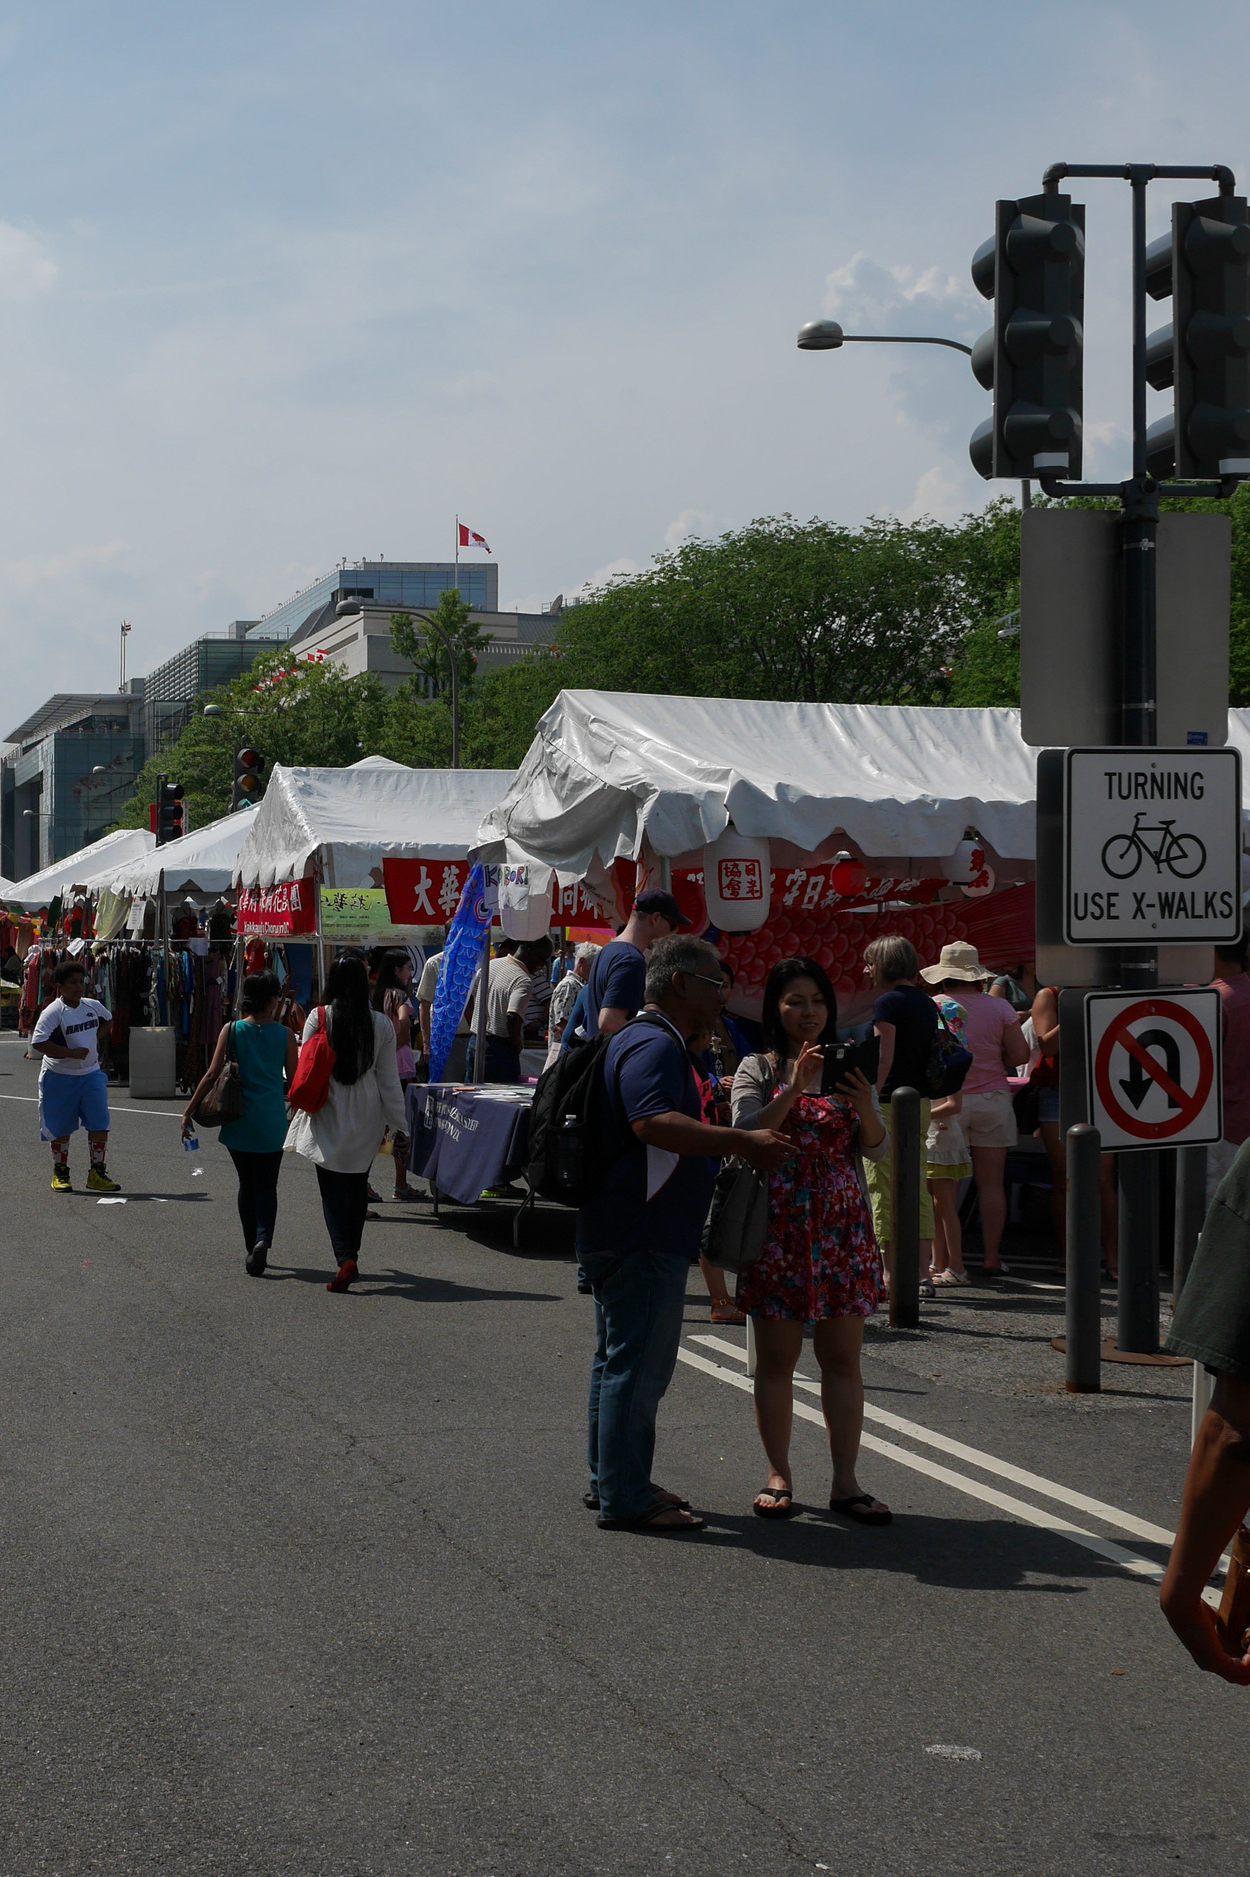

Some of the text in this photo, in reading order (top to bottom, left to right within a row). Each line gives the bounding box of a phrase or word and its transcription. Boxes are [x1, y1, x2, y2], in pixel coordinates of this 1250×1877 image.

[1104, 771, 1204, 800] TURNING
[1074, 891, 1233, 921] USE X-WALKS
